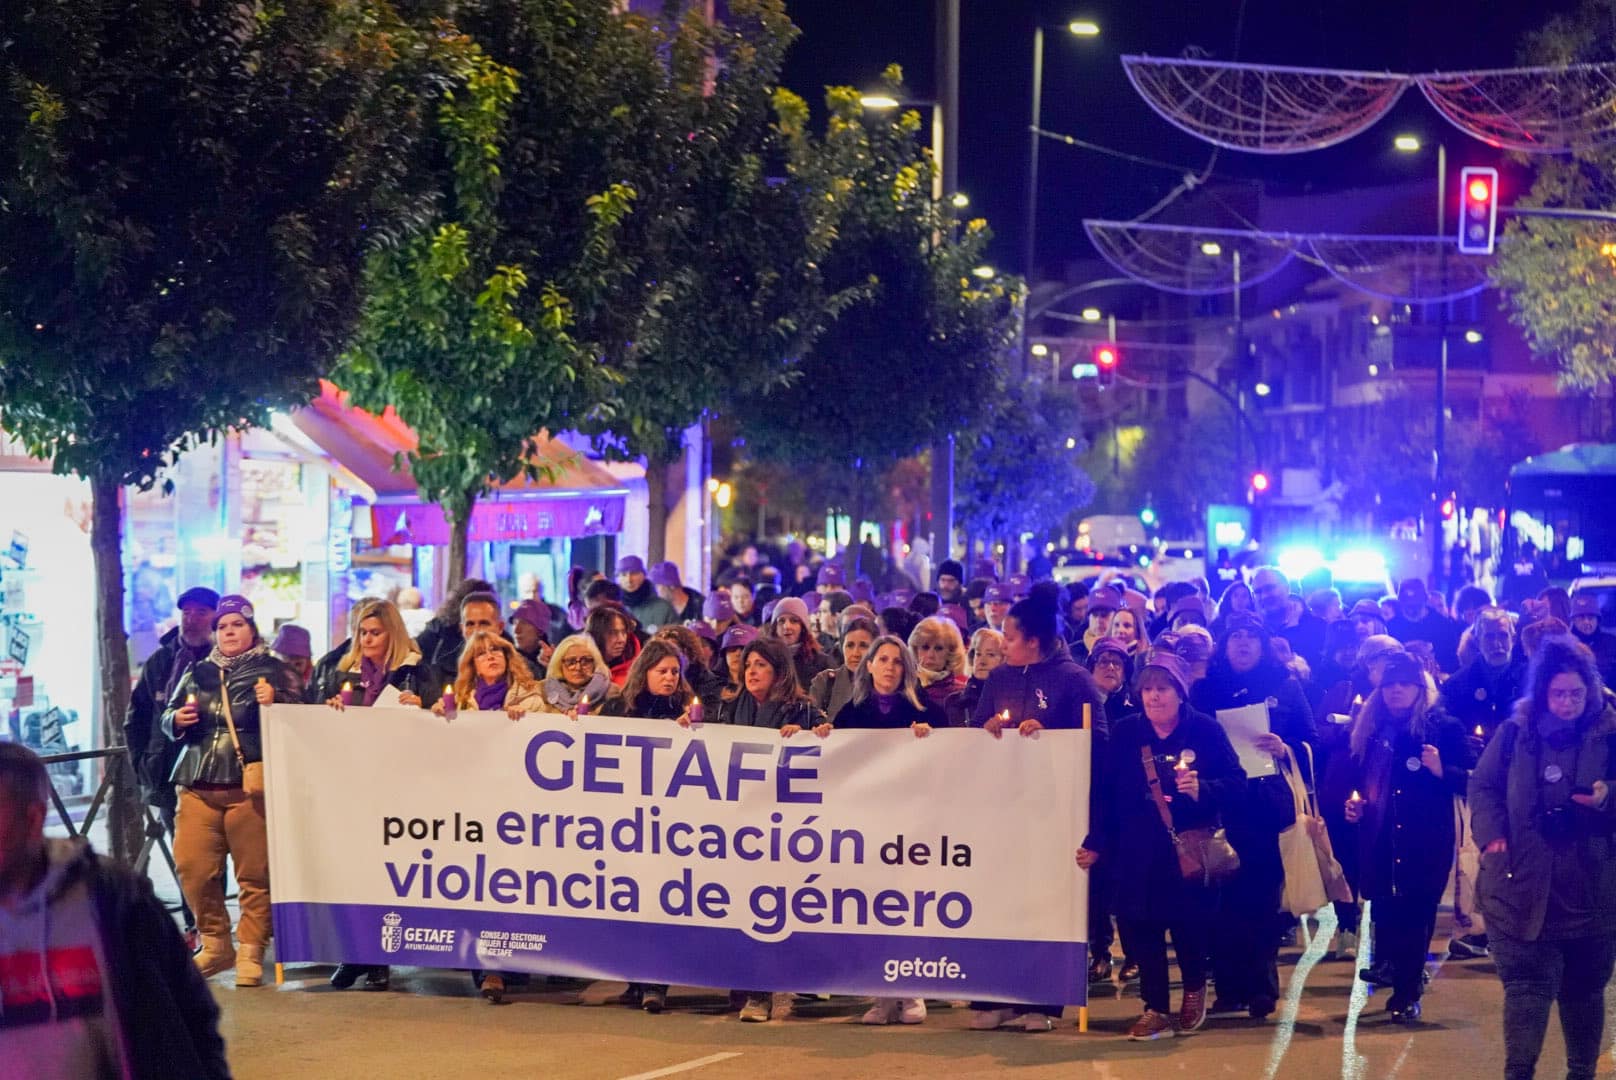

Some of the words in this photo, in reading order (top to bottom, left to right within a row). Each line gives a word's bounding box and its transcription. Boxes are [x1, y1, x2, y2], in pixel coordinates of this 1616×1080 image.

[525, 729, 824, 805] GETAFE
[383, 815, 446, 846] por
[453, 812, 484, 843] la
[496, 805, 865, 865] erradicación
[879, 834, 931, 866] de
[940, 835, 972, 867] la
[384, 848, 640, 914] violencia
[658, 867, 731, 919] de
[748, 873, 974, 935] género
[404, 927, 456, 944] GETAFE
[480, 930, 510, 941] CONSEJO
[510, 932, 547, 944] SECTORIAL
[508, 941, 543, 951] IGUALDAD
[404, 942, 454, 953] AYUNTAMIENTO
[883, 955, 967, 983] getafe.
